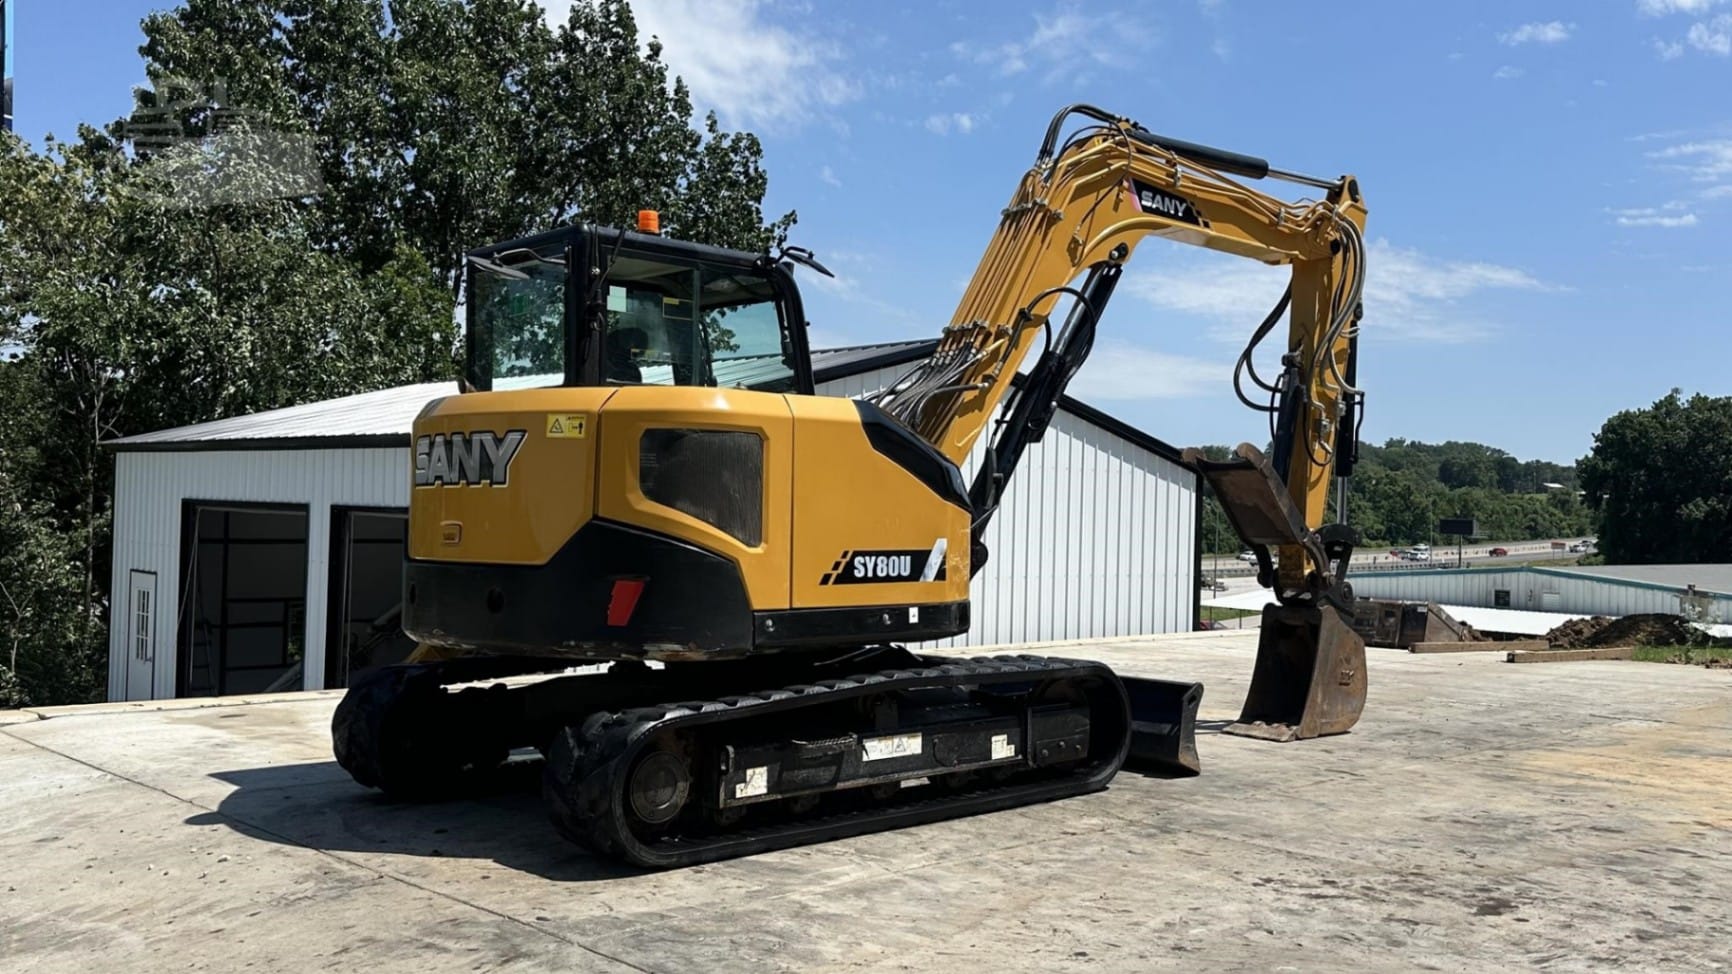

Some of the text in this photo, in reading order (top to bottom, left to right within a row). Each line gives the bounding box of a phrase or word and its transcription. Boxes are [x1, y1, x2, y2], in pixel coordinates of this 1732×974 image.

[1141, 190, 1188, 217] SANY
[415, 430, 527, 488] SANY
[853, 555, 912, 578] SY80U
